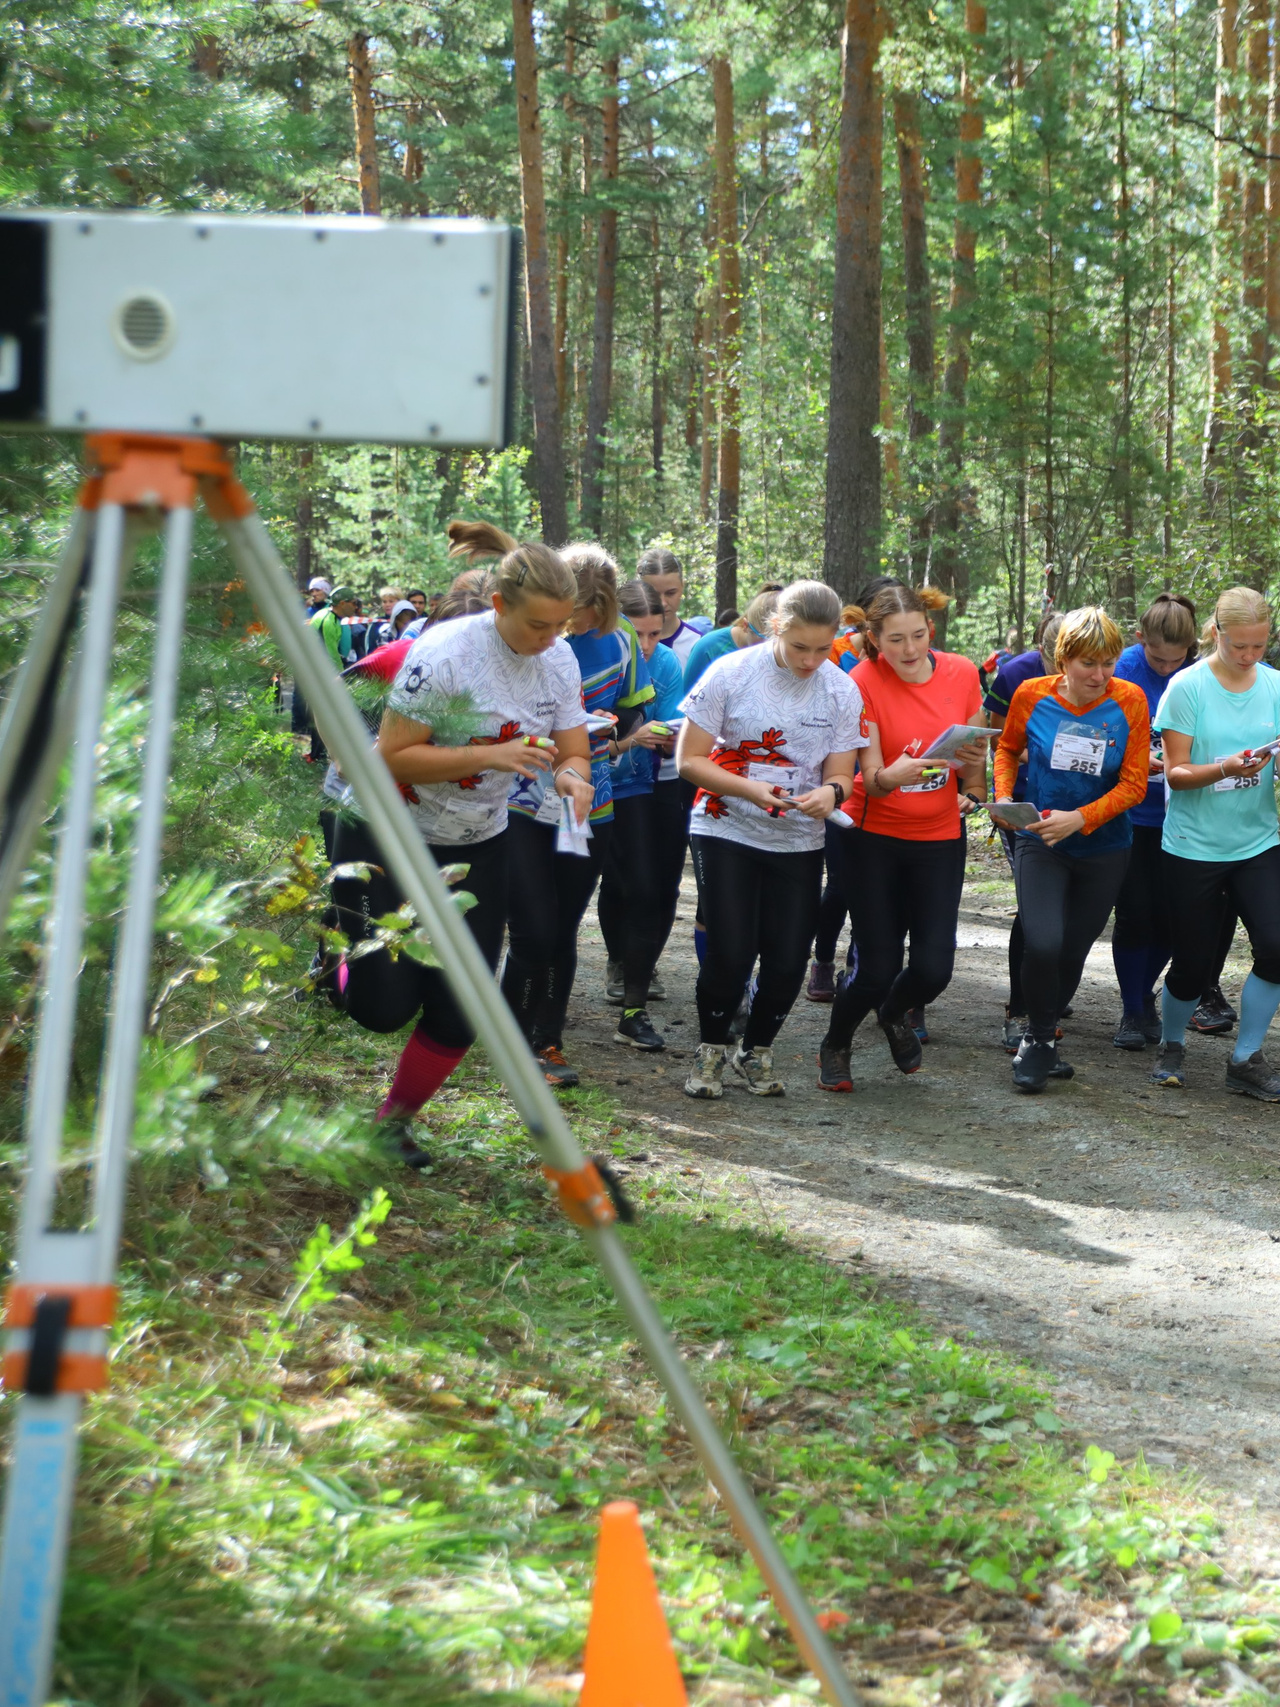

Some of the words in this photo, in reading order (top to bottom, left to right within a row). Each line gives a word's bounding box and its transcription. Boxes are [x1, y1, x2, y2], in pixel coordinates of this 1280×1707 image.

[1070, 759, 1098, 775] 255
[921, 774, 947, 790] 254
[1234, 773, 1260, 789] 256
